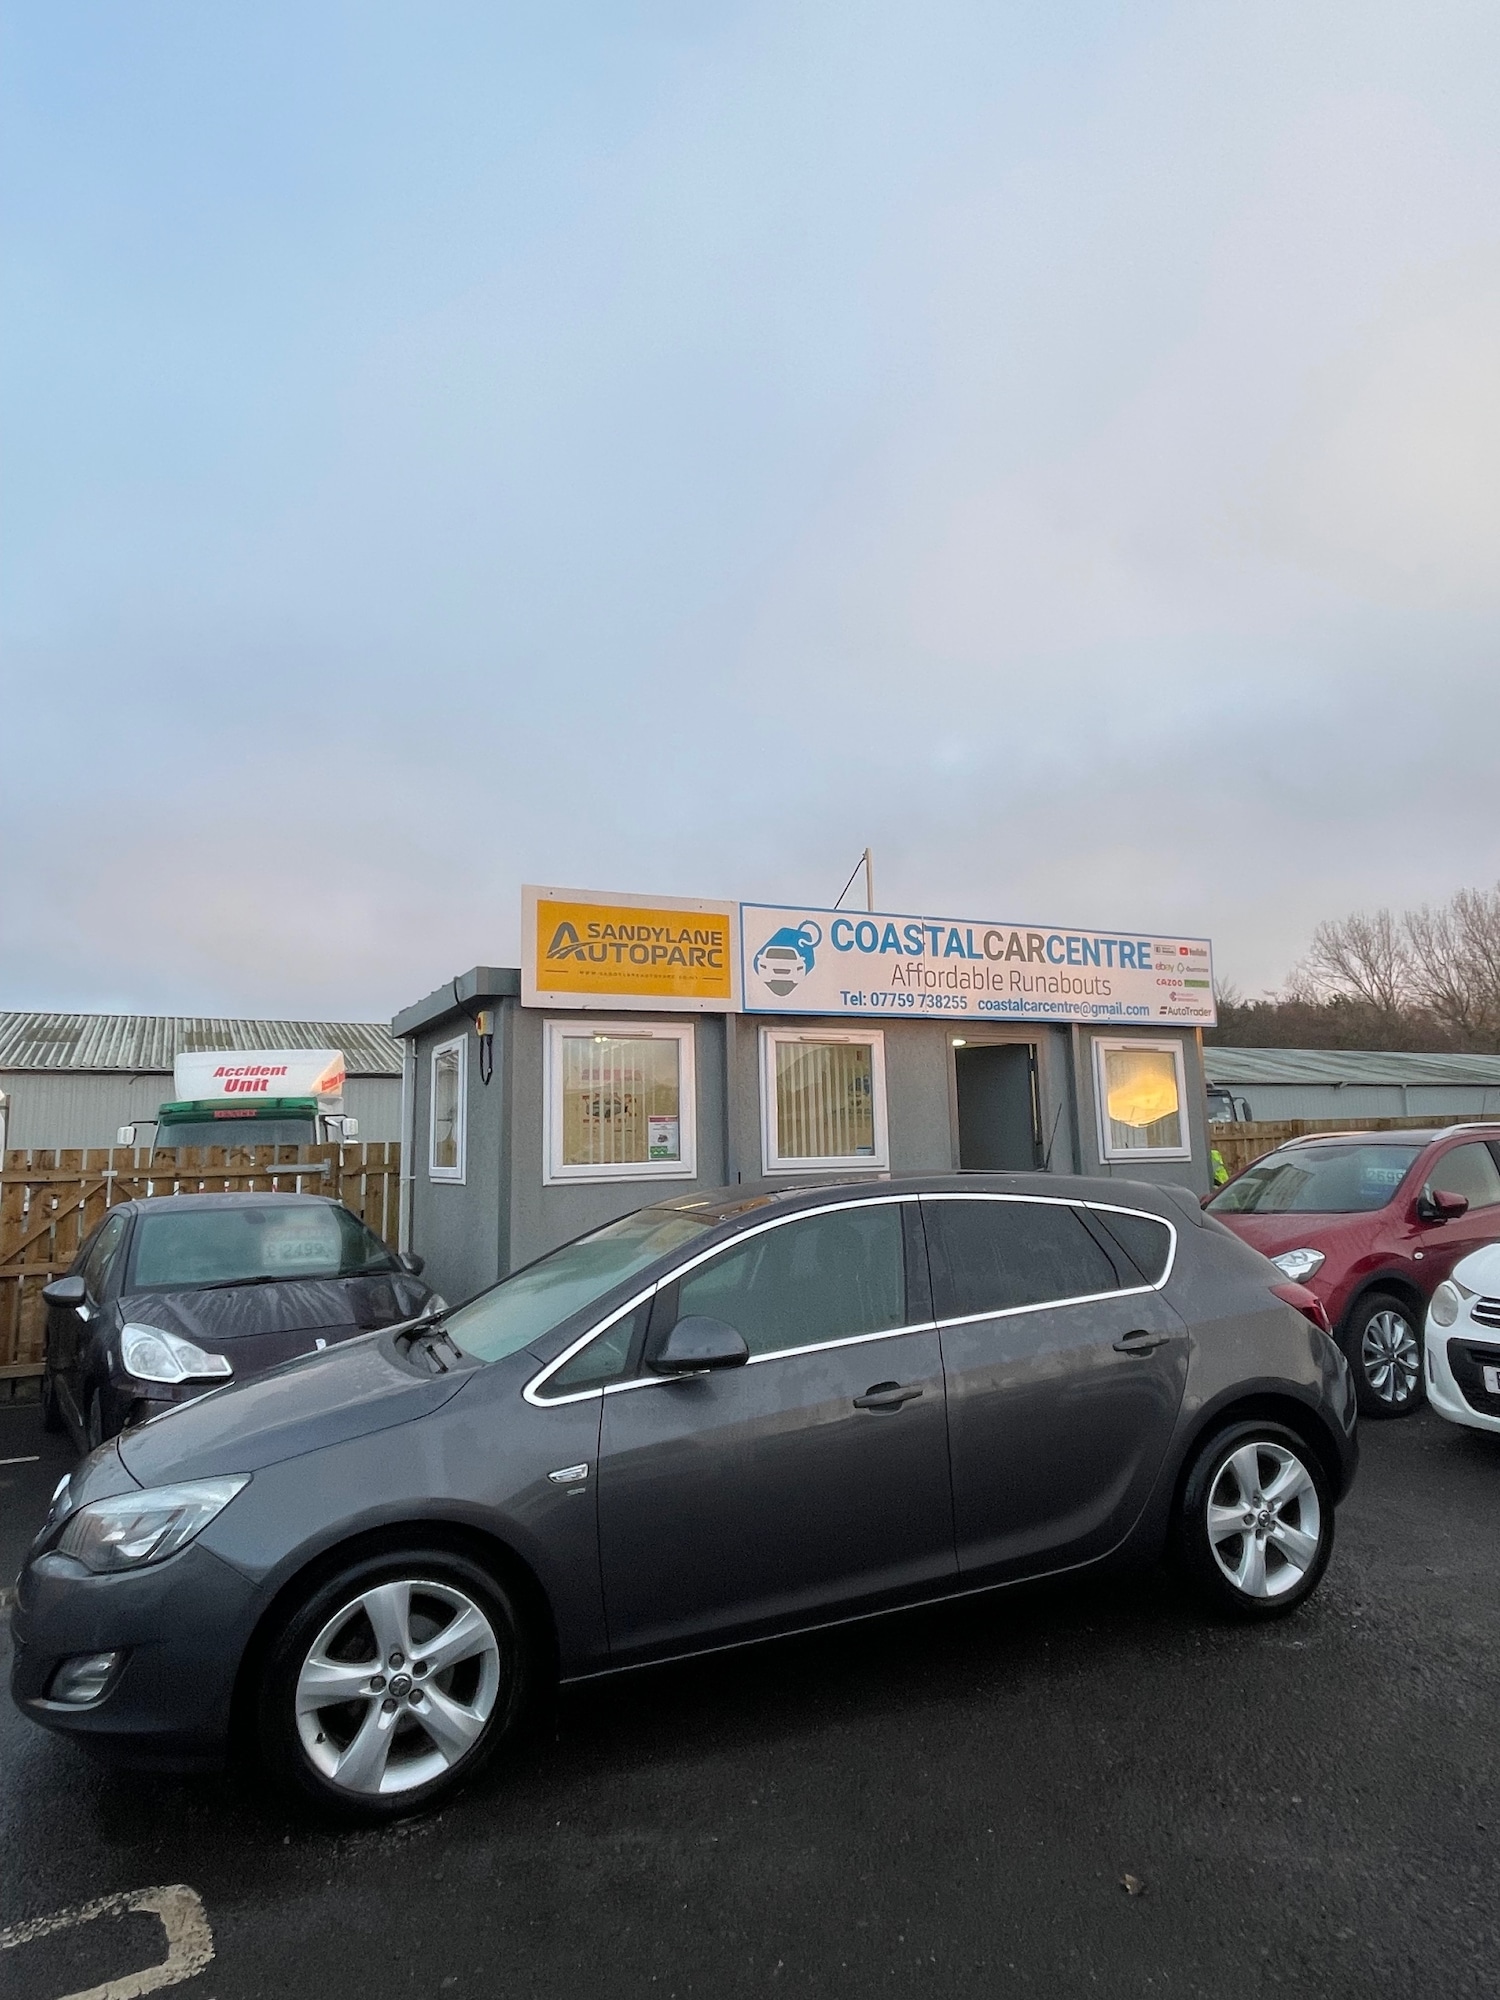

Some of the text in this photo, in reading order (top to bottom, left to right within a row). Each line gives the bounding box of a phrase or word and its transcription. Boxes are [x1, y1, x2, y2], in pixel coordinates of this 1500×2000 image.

[587, 923, 723, 946] SANDYLANE
[831, 918, 1153, 970] COASTALCARCENTRE
[1155, 962, 1175, 973] ebay
[891, 962, 1112, 996] Affordable Runabouts
[840, 991, 968, 1010] Tel: 07759 738255
[978, 998, 1150, 1017] coastalcarcentre@gmail.com
[1167, 1006, 1212, 1017] AutoTrader
[212, 1066, 288, 1077] Accident
[224, 1079, 269, 1092] Unit
